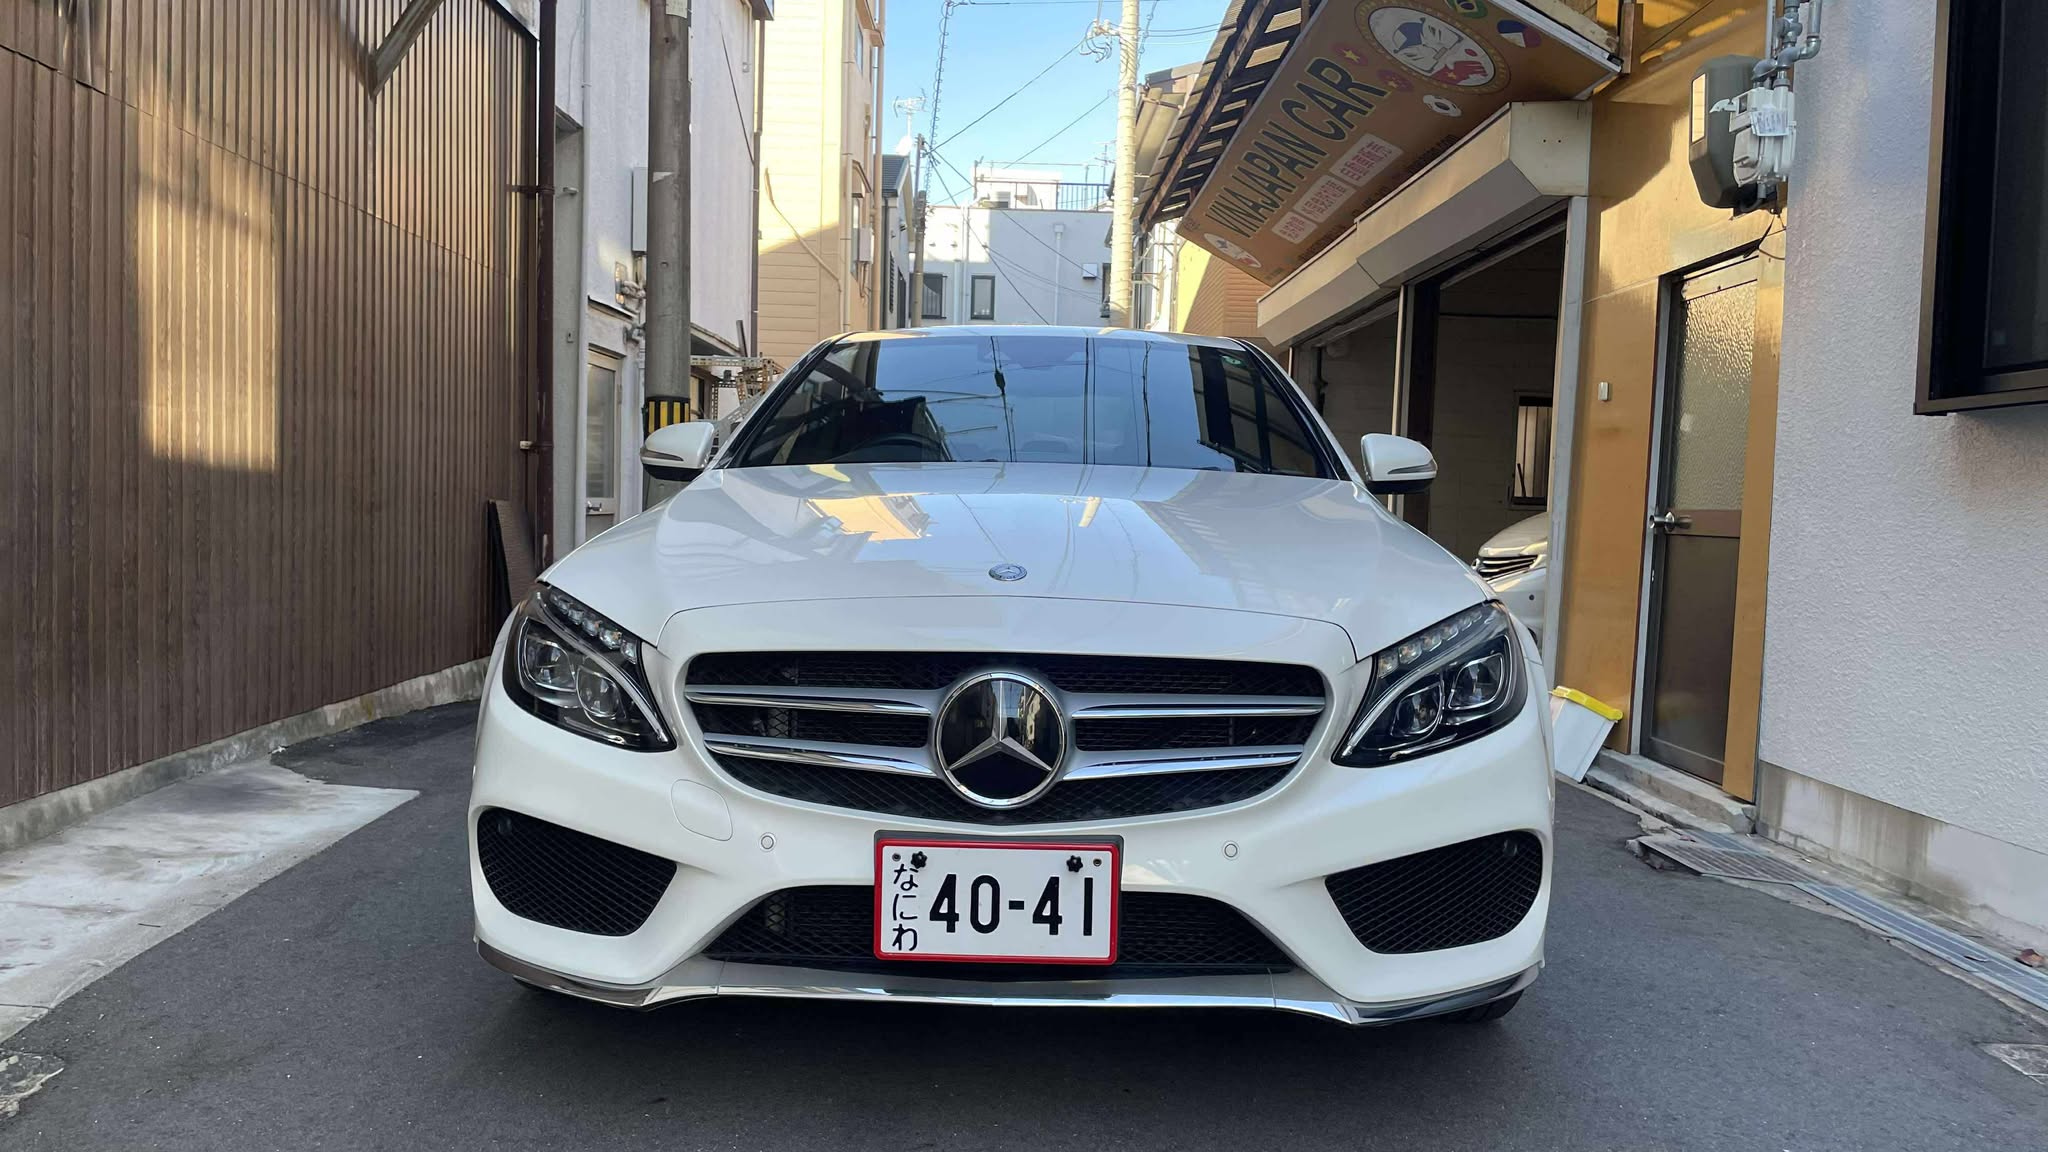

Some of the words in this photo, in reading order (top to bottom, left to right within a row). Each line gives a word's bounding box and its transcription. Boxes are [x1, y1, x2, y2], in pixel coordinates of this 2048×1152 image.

[1206, 121, 1331, 238] VINAJAPAN
[1282, 58, 1388, 141] CAR
[1340, 141, 1392, 181] 自動車販売
[892, 864, 919, 951] なにわ
[929, 873, 1093, 936] 40-41
